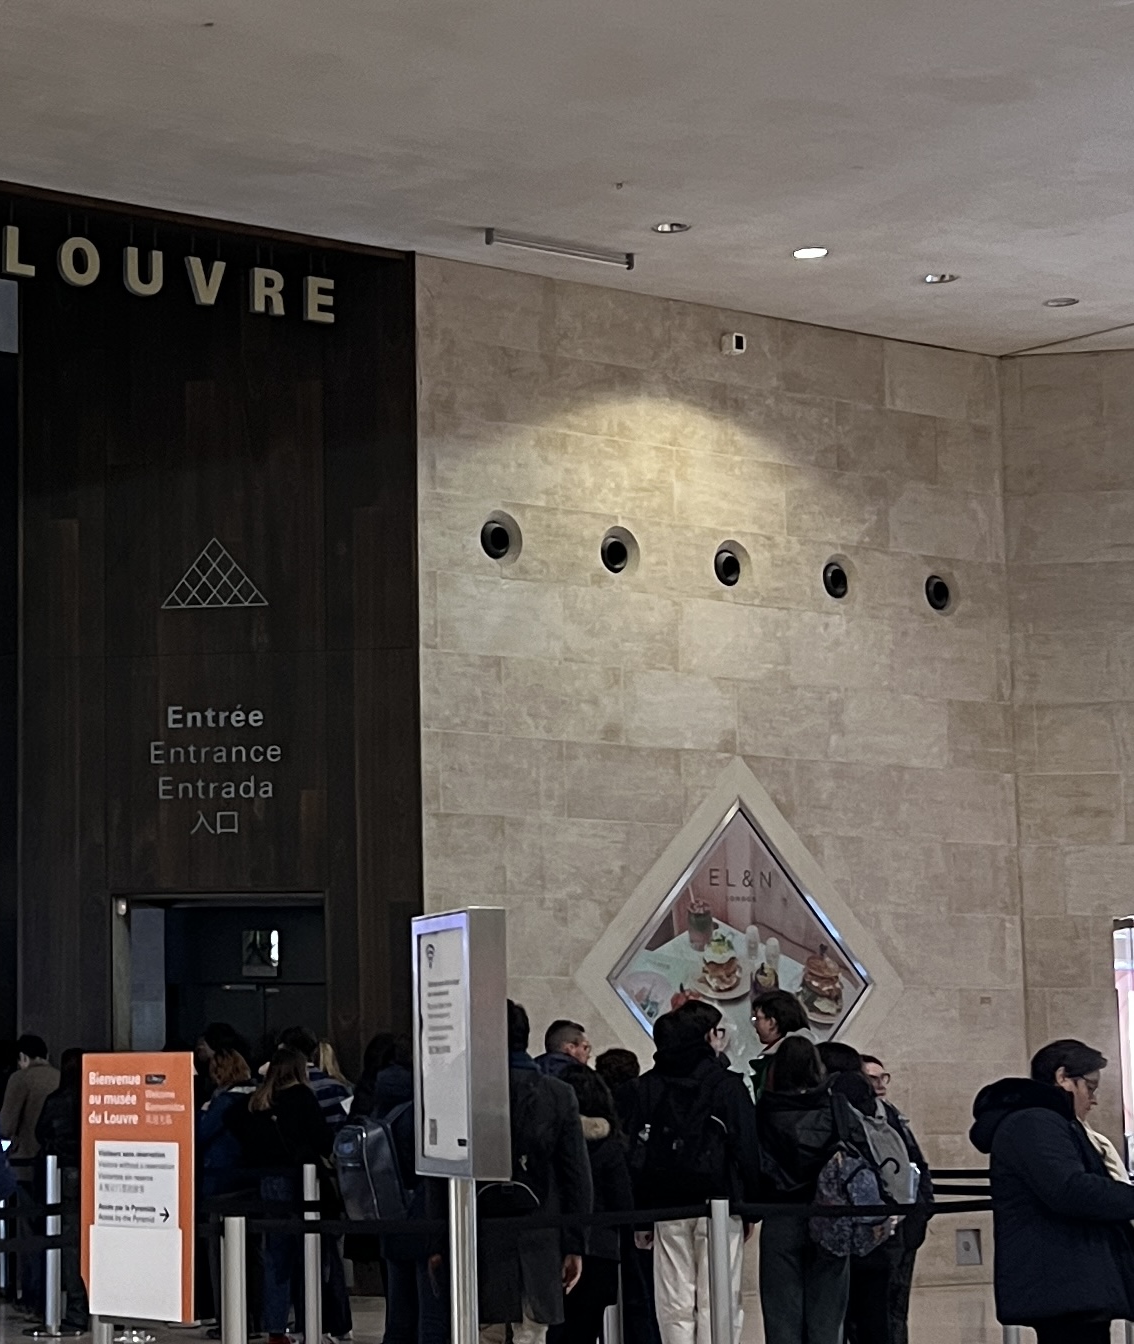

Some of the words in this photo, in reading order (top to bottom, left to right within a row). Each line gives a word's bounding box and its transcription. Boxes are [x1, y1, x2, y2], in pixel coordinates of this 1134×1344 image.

[2, 225, 335, 324] LOUVRE
[167, 703, 264, 728] Entrée
[149, 741, 282, 764] Entrance
[158, 775, 274, 800] Entrada
[189, 809, 240, 835] 入口
[708, 868, 772, 888] EL&N
[88, 1071, 141, 1086] Bienvenue
[88, 1094, 102, 1105] au
[103, 1090, 137, 1105] musée
[88, 1110, 102, 1124] du
[103, 1110, 139, 1125] Louvre
